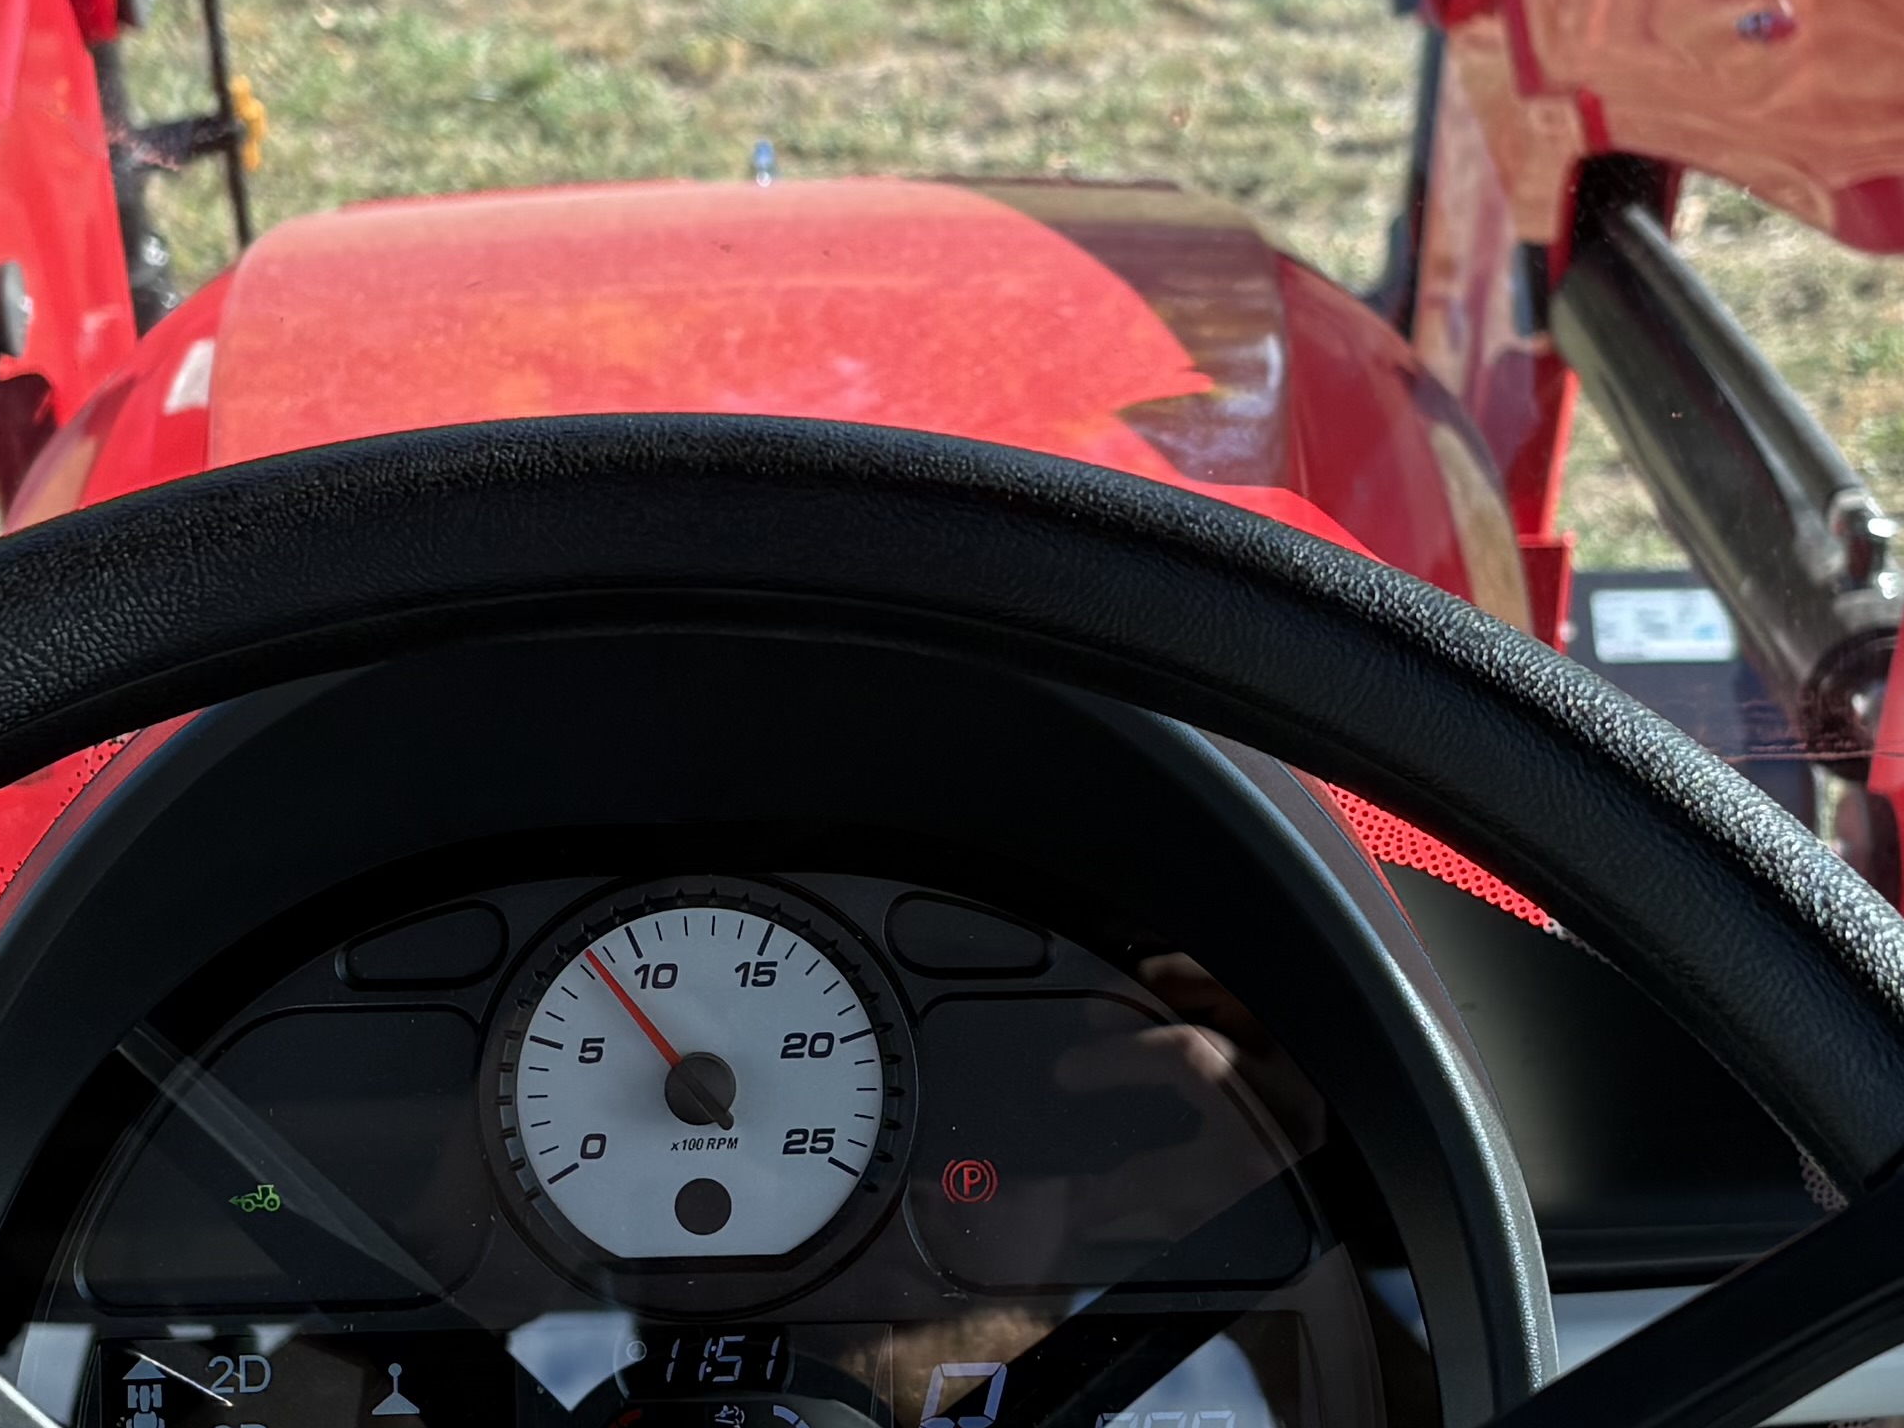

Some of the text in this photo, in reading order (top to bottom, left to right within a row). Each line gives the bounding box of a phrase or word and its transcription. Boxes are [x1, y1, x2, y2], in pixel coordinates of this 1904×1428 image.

[633, 962, 679, 990] 10
[734, 960, 779, 988] 15
[578, 1037, 606, 1064] 5
[780, 1031, 835, 1060] 20
[580, 1133, 607, 1160] 0
[706, 1137, 739, 1150] RPM
[782, 1128, 836, 1155] 25
[963, 1167, 983, 1197] P
[666, 1335, 781, 1383] 11:51
[208, 1354, 272, 1394] 2D
